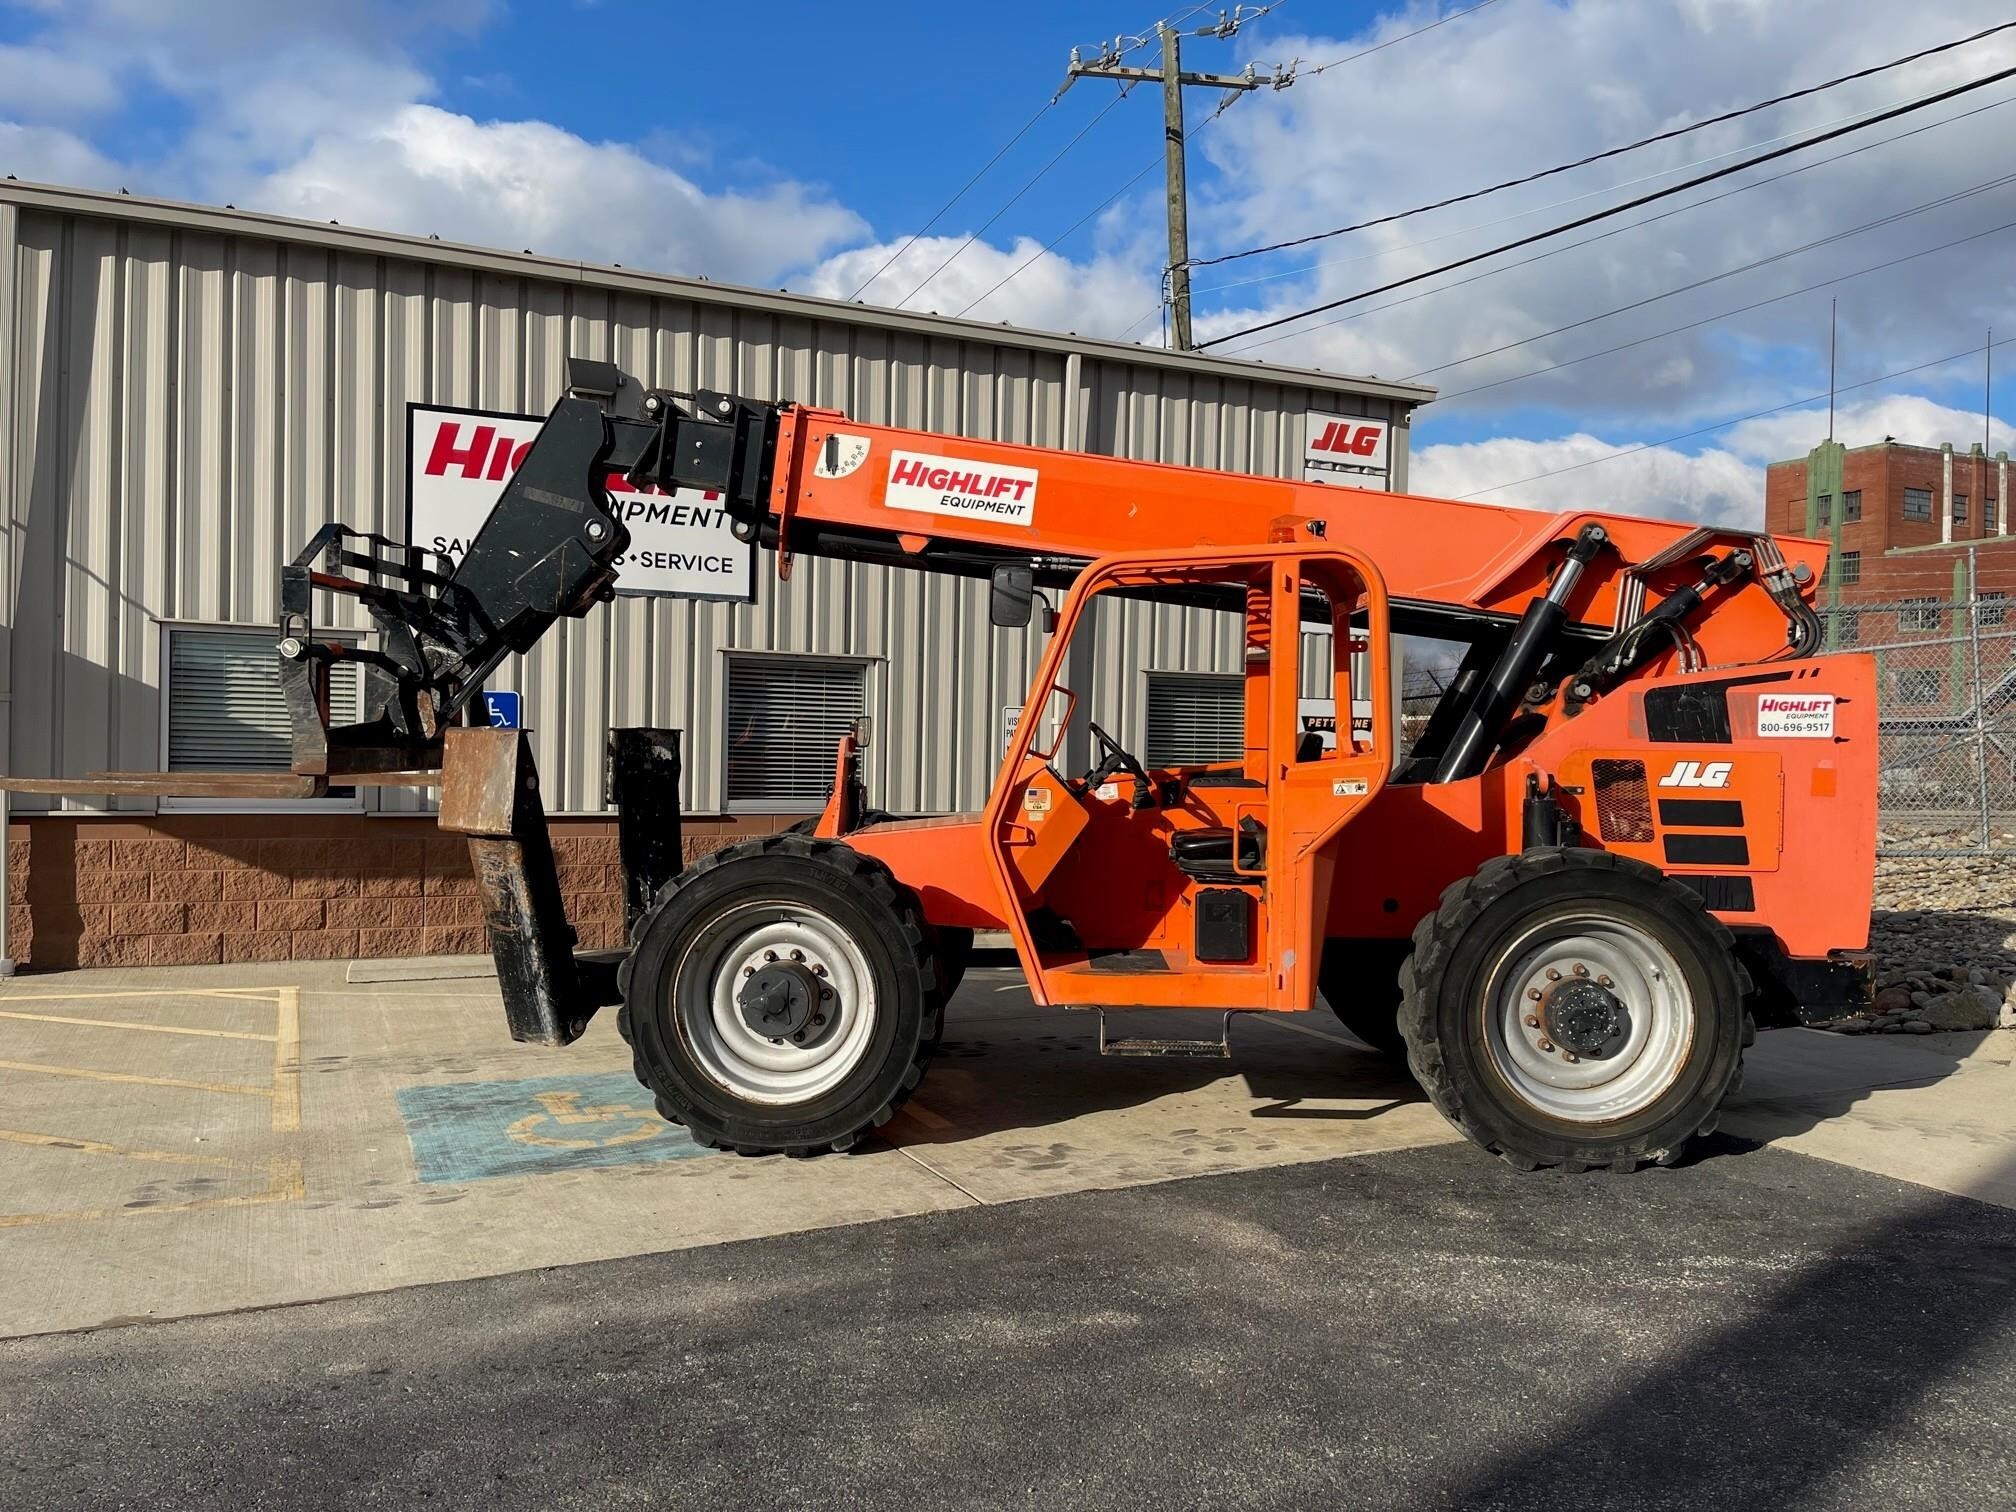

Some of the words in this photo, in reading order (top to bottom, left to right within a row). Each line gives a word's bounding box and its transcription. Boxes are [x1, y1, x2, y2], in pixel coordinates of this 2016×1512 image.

[1311, 422, 1381, 457] JLG
[891, 459, 1033, 500] HIGHLIFT
[940, 495, 1025, 516] EQUIPMENT
[640, 551, 733, 573] SERVICE
[1760, 699, 1831, 712] HIGHLIFT
[1760, 723, 1830, 732] 800-696-9517
[1658, 761, 1733, 787] JLG
